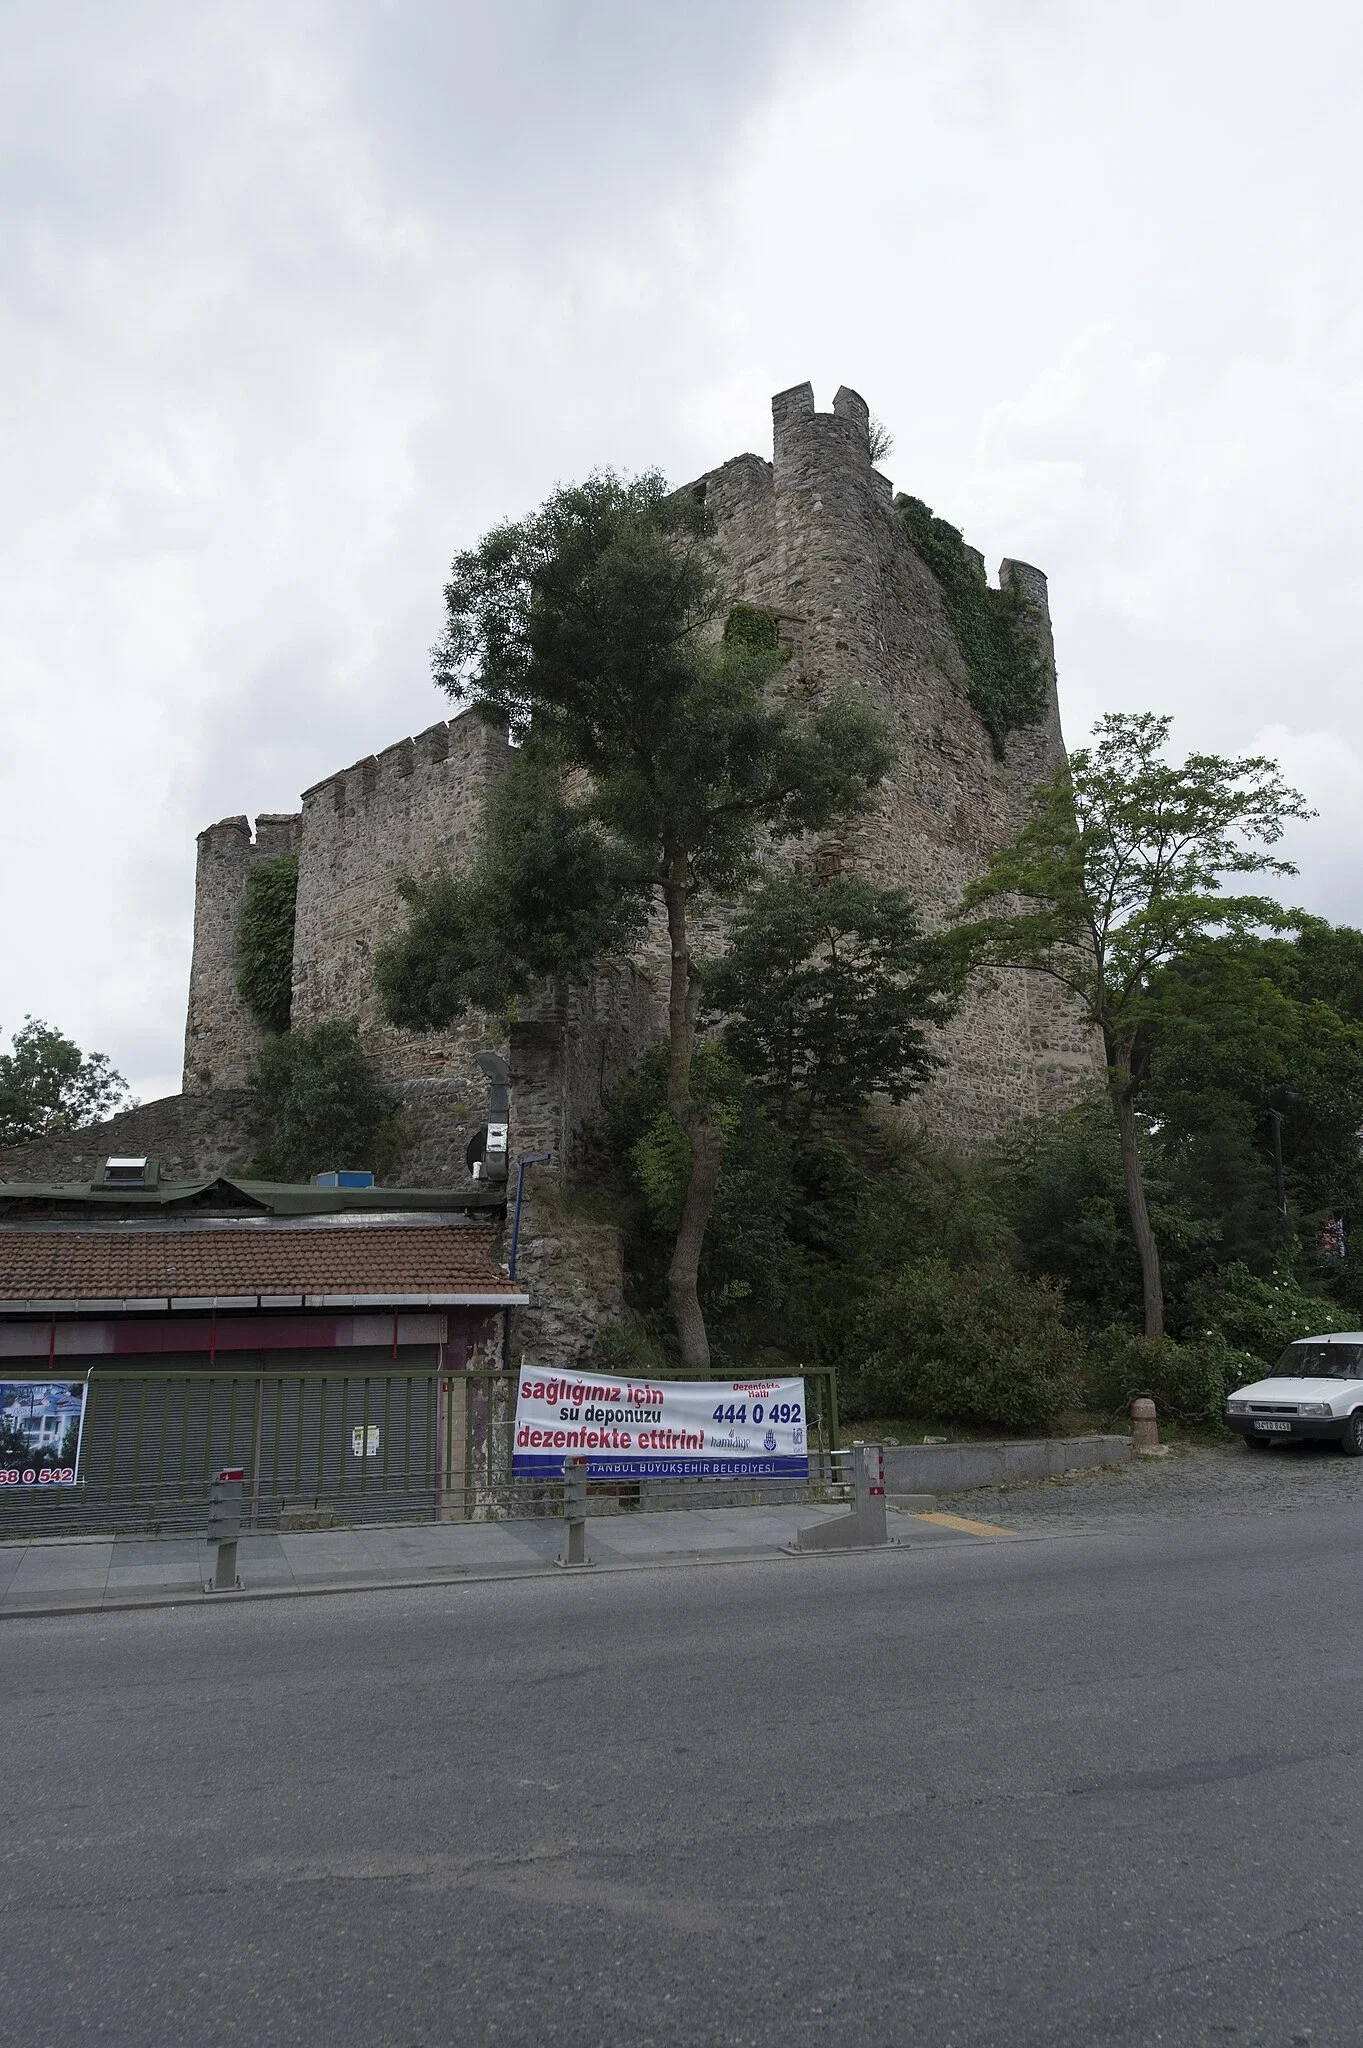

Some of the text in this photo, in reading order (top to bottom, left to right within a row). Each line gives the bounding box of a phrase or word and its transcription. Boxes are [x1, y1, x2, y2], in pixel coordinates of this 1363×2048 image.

[521, 1377, 664, 1408] sağlığınız için
[560, 1407, 579, 1421] su
[712, 1403, 801, 1424] 444 0 492
[517, 1426, 705, 1450] dezenfekte ettirin!
[23, 1469, 35, 1483] 0
[39, 1468, 73, 1483] 542
[586, 1463, 636, 1473] STANBUL
